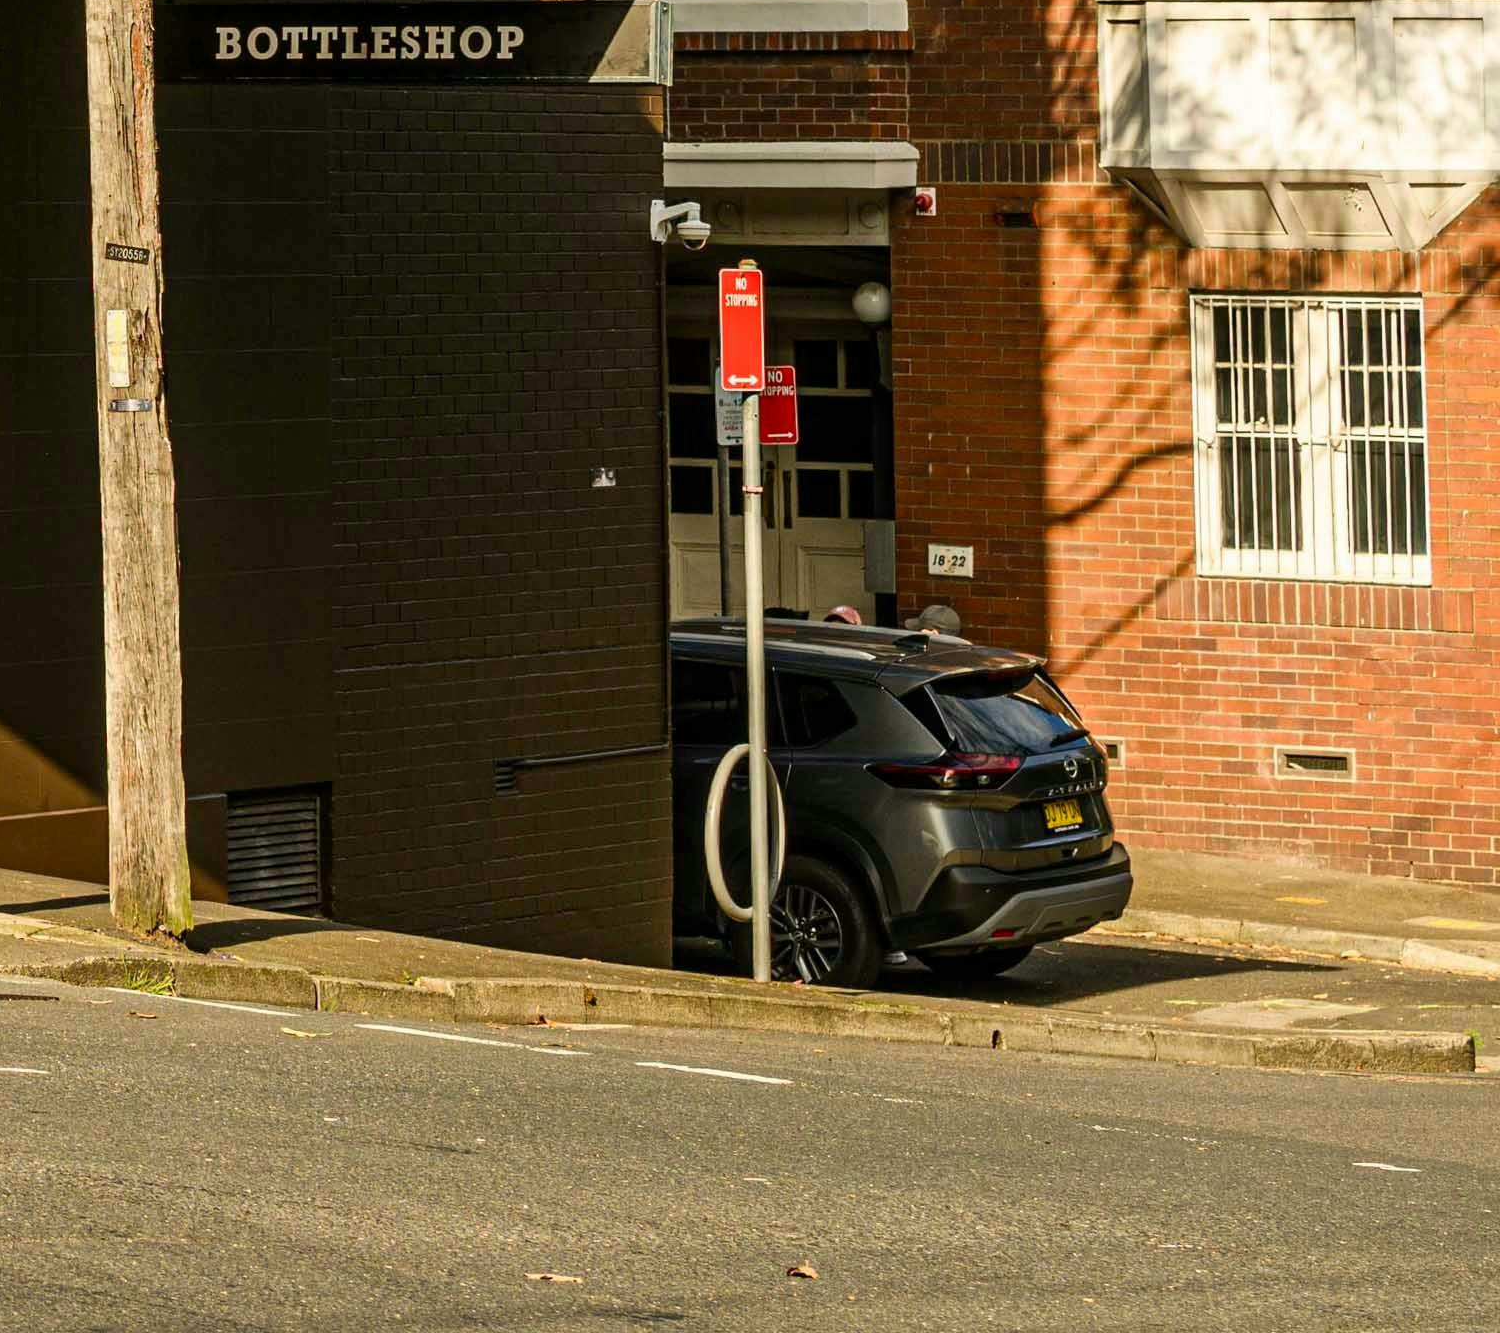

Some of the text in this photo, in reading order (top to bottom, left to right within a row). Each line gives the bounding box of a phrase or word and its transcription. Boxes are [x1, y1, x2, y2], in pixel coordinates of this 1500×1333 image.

[215, 26, 524, 60] BOTTLESHOP
[735, 277, 747, 291] NO
[725, 294, 758, 307] STOPPING
[767, 371, 783, 384] NO
